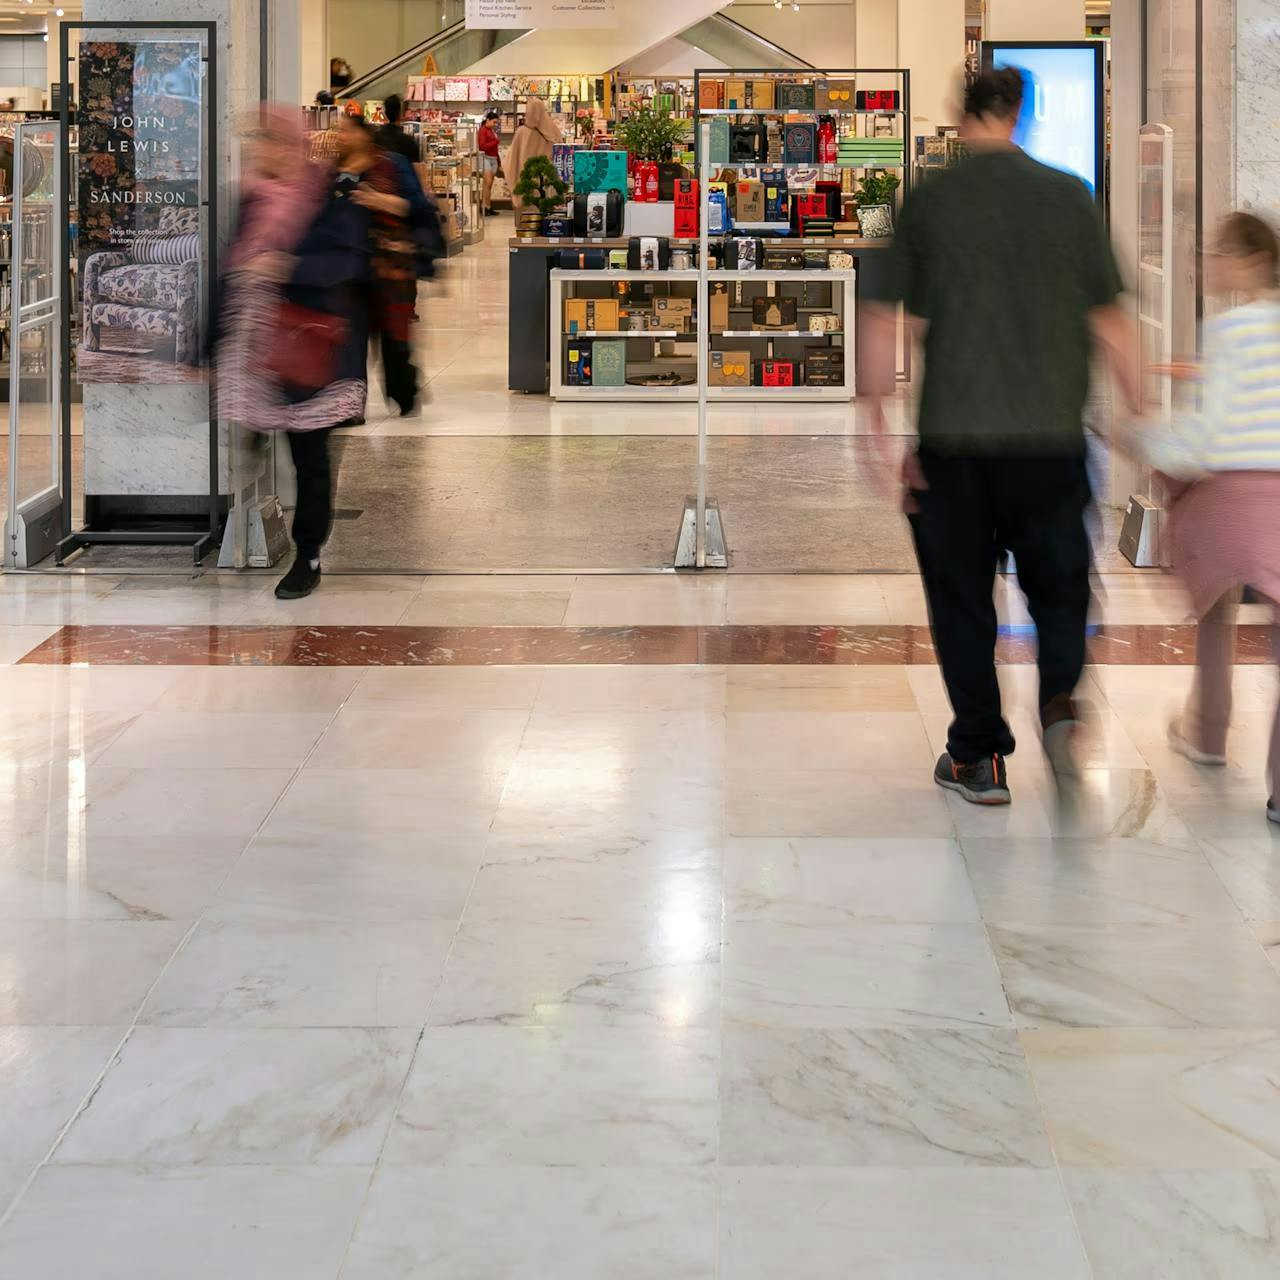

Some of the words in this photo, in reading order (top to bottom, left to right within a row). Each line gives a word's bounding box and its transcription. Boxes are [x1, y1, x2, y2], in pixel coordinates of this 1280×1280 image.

[113, 116, 165, 130] JOHN
[107, 140, 170, 153] LEWIS
[90, 190, 186, 204] SANDERSON
[109, 228, 125, 237] Shop
